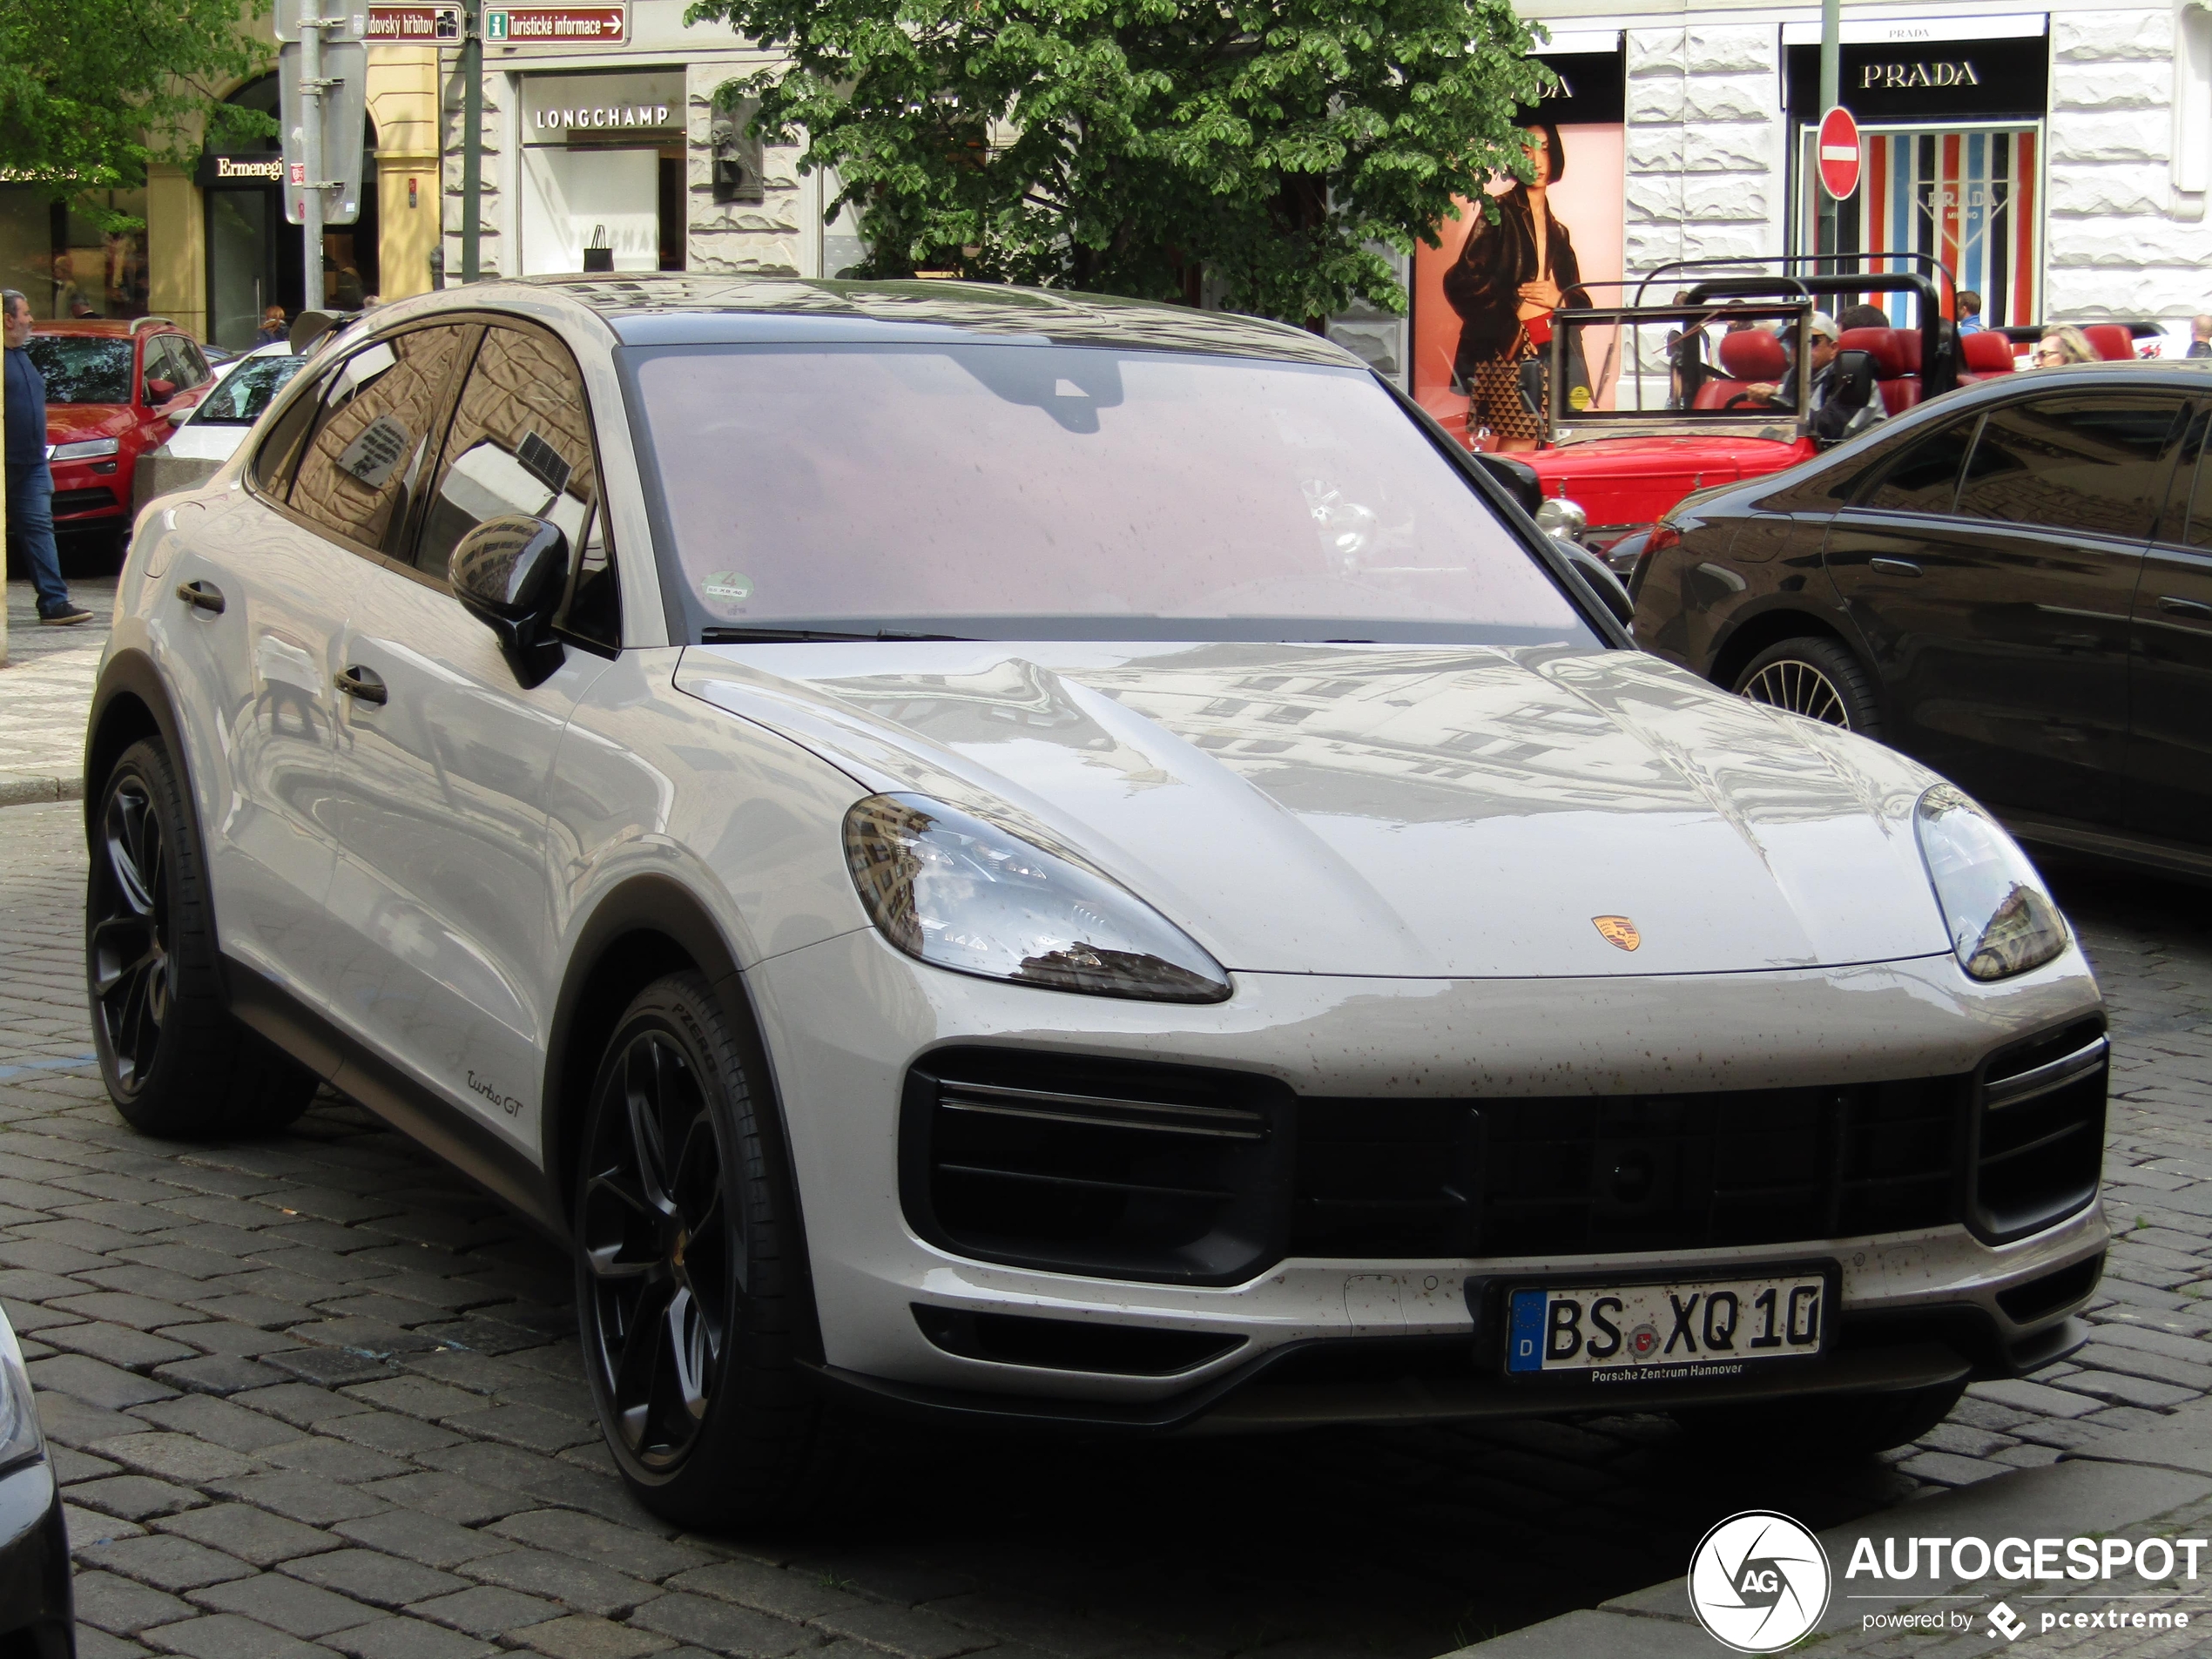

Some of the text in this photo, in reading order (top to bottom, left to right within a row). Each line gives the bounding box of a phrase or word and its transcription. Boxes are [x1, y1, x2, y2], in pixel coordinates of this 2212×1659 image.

[368, 14, 401, 39] idovský
[403, 14, 434, 34] hřbitov
[509, 15, 553, 36] Turistické
[555, 15, 602, 35] informace
[1889, 29, 1930, 38] PRADA
[1858, 61, 1979, 88] PRADA
[536, 107, 669, 129] LONGCHAMP
[218, 157, 284, 181] Ermenegi
[1927, 192, 1998, 207] PRADA
[722, 571, 736, 586] 4
[468, 1070, 524, 1118] Turbo GT
[1545, 1297, 1623, 1360] BS
[1663, 1291, 1738, 1354] XQ
[1750, 1285, 1818, 1348] 10
[1520, 1339, 1533, 1357] D
[1592, 1364, 1743, 1382] Porsche Zentrum Hannover
